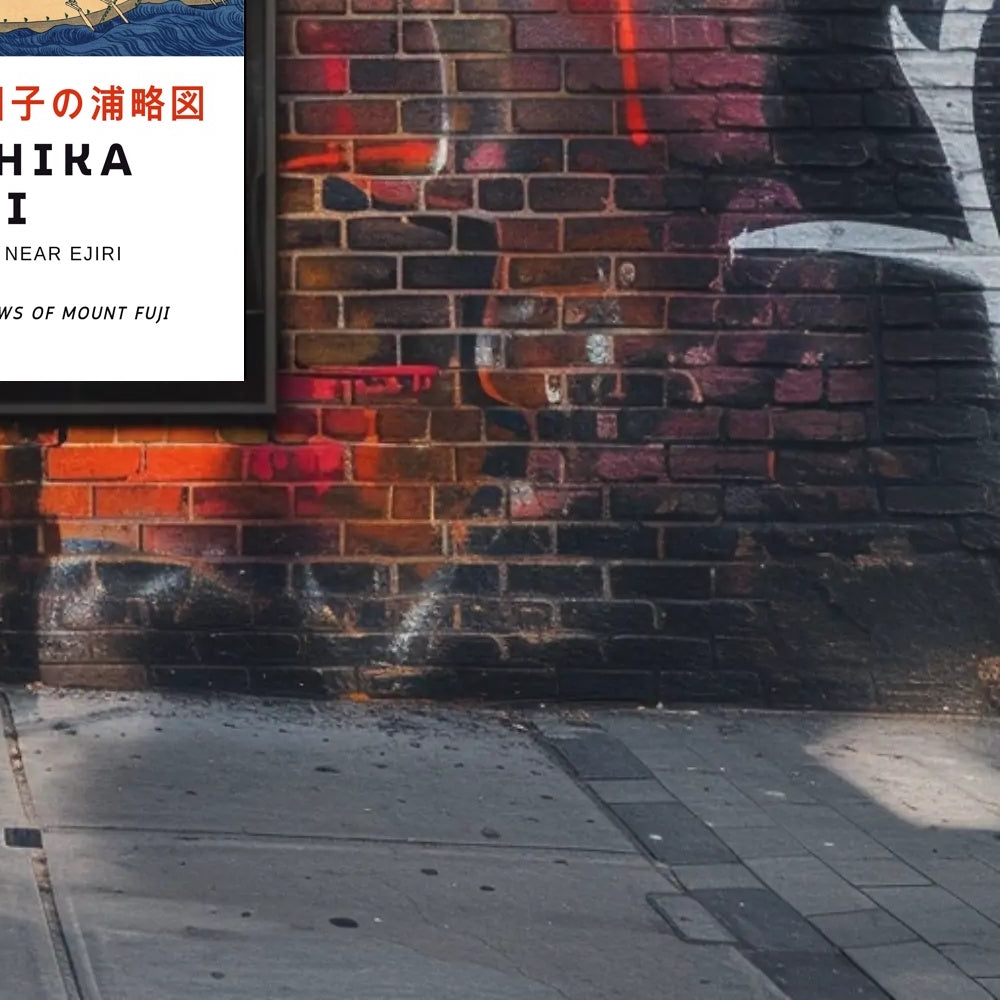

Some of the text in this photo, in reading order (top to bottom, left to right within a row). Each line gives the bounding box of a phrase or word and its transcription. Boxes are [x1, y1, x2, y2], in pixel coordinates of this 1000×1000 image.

[5, 245, 61, 262] NEAR
[70, 245, 121, 262] EJIRI
[31, 305, 56, 321] OF
[61, 305, 128, 321] MOUNT
[134, 305, 171, 325] FUJI
